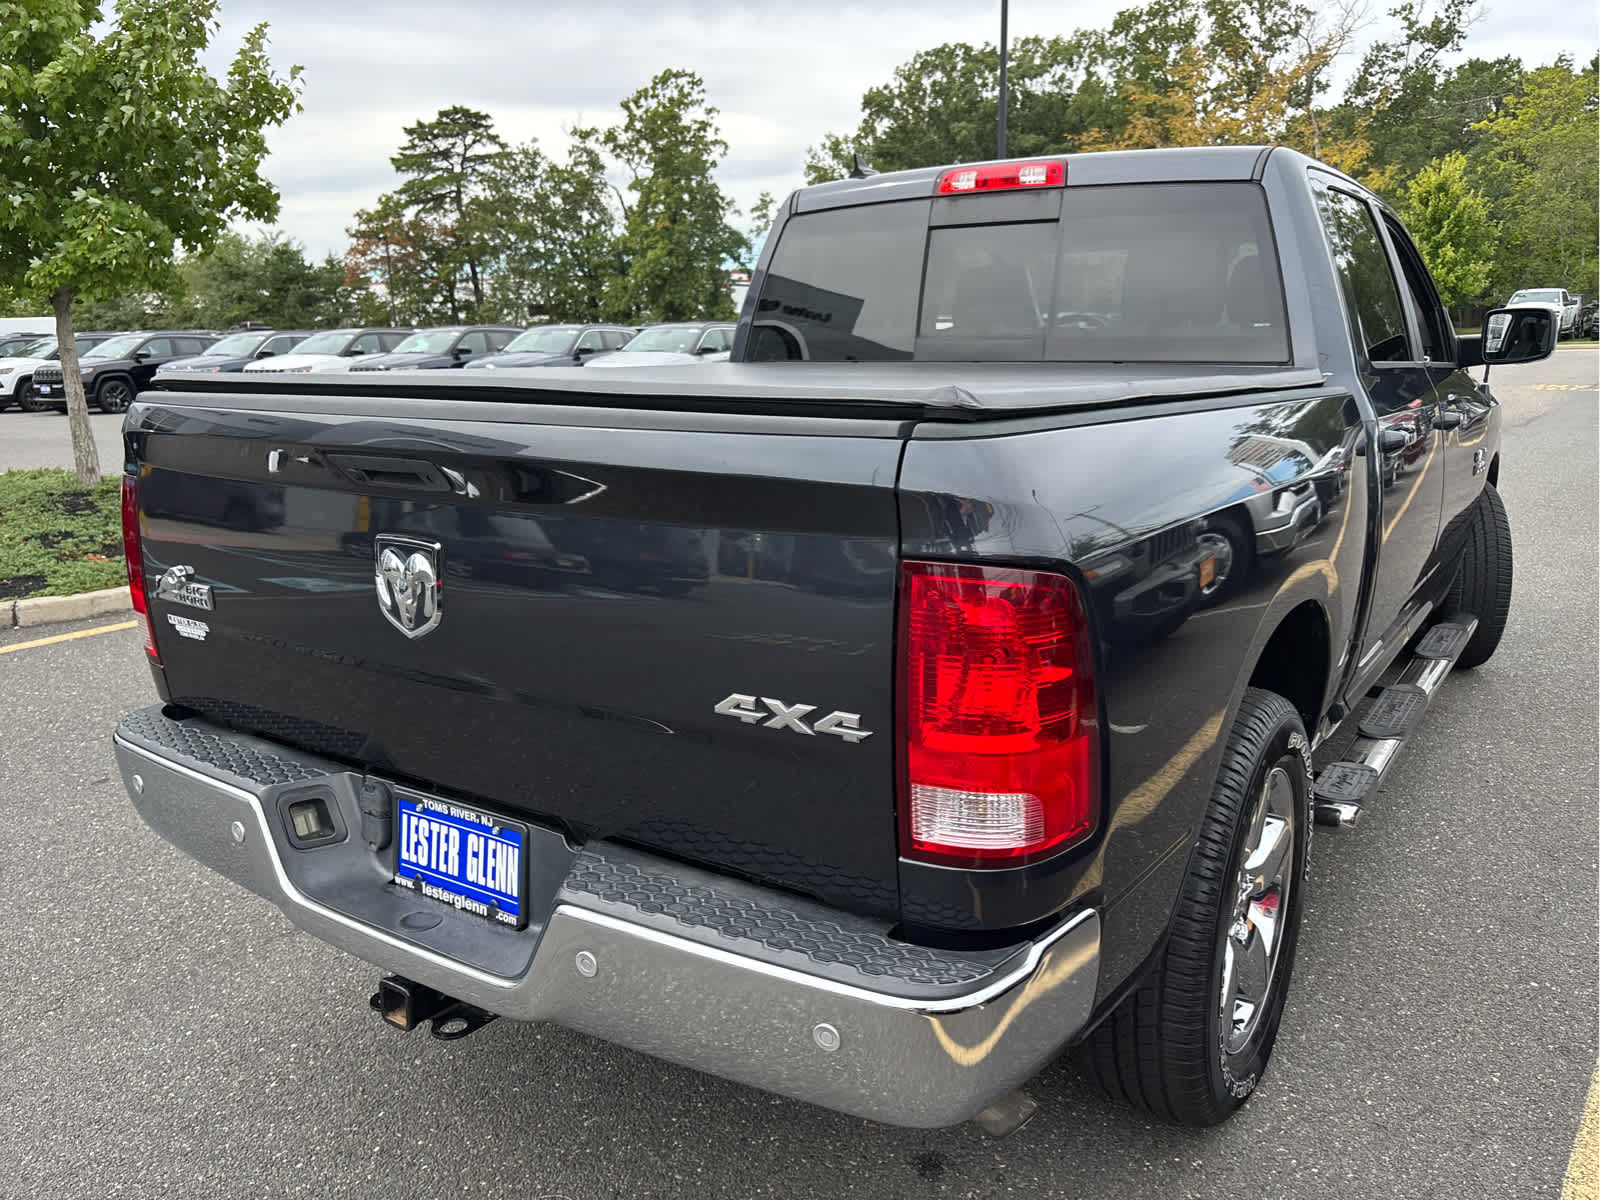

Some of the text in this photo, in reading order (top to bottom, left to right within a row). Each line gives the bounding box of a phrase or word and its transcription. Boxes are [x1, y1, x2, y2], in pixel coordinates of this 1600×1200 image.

[186, 585, 206, 597] BIG
[422, 799, 494, 827] TOMS RIVER, NJ
[402, 813, 519, 897] LESTER GLENN
[394, 875, 517, 926] www. lesterglenn .com
